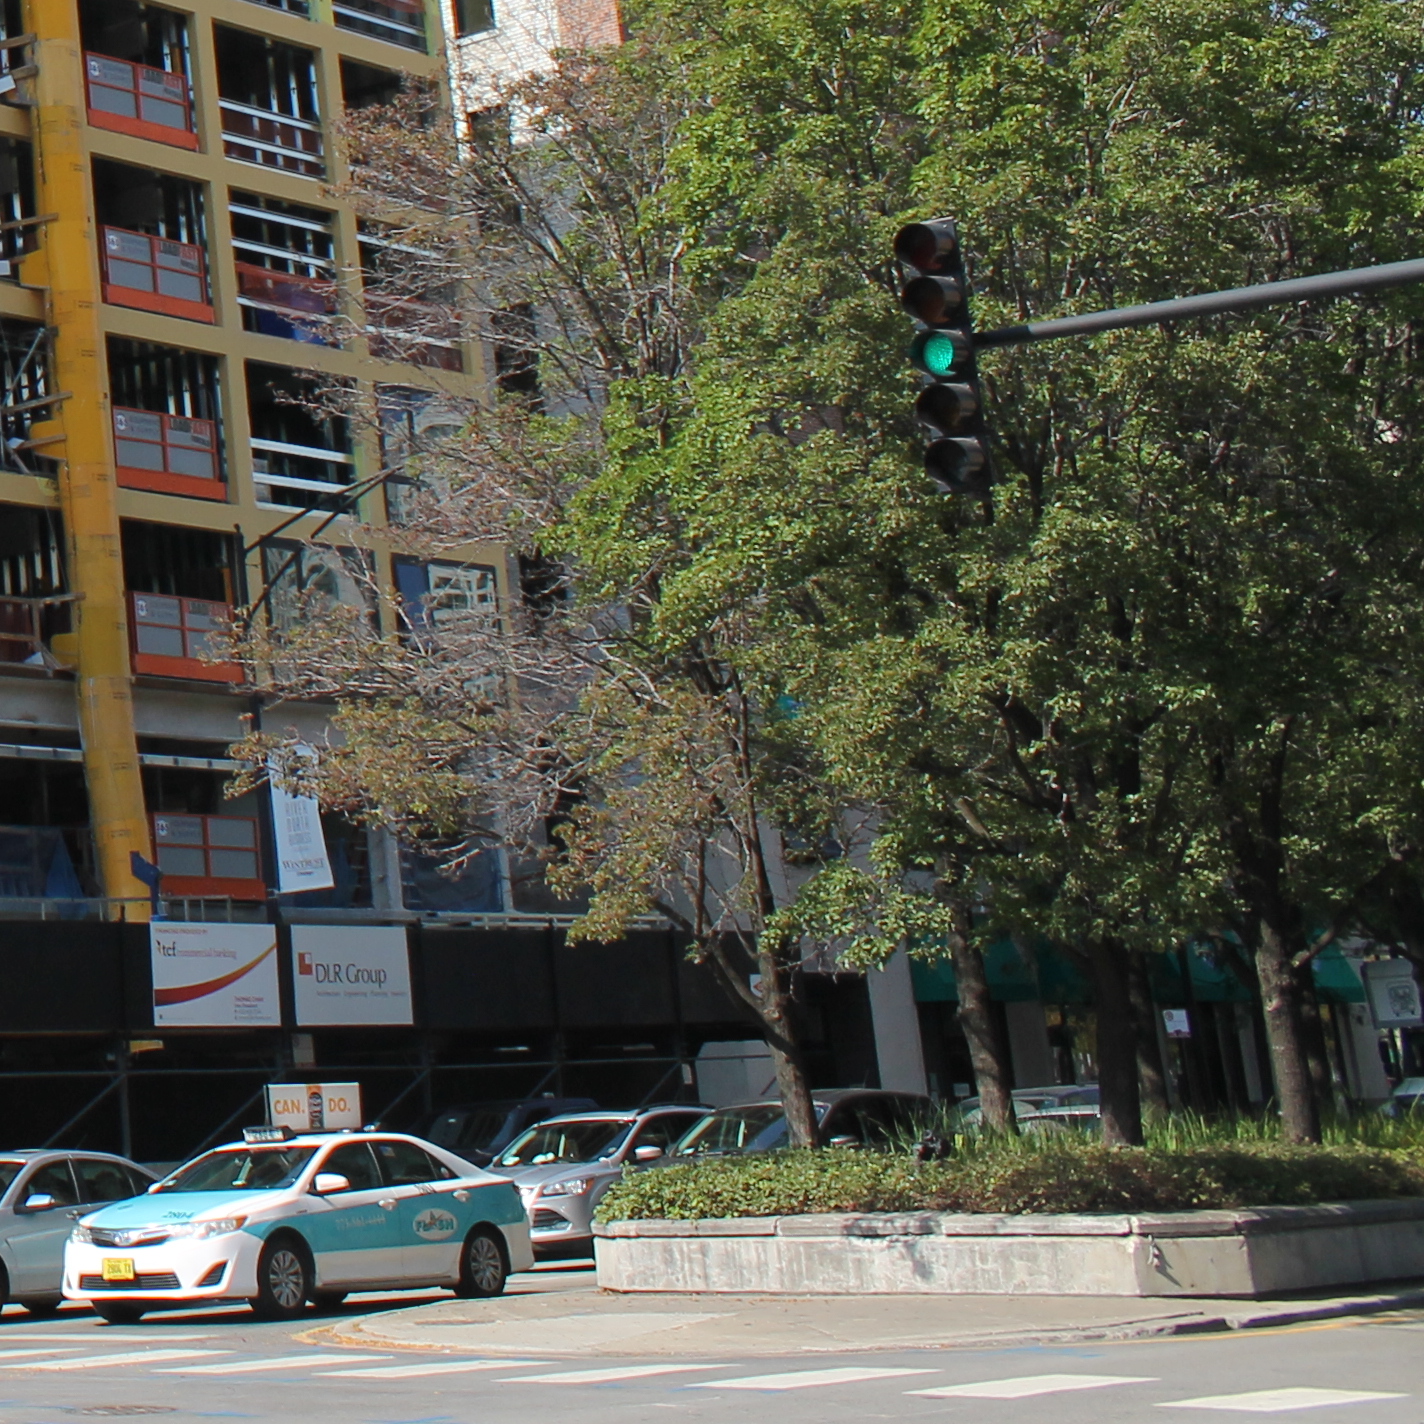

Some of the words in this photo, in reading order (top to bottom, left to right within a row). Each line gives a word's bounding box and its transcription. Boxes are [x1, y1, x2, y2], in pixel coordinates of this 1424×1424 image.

[162, 941, 177, 957] tcf
[315, 963, 344, 984] DLR
[345, 963, 387, 988] Group
[274, 1099, 305, 1115] CAN.
[328, 1097, 351, 1113] DO.
